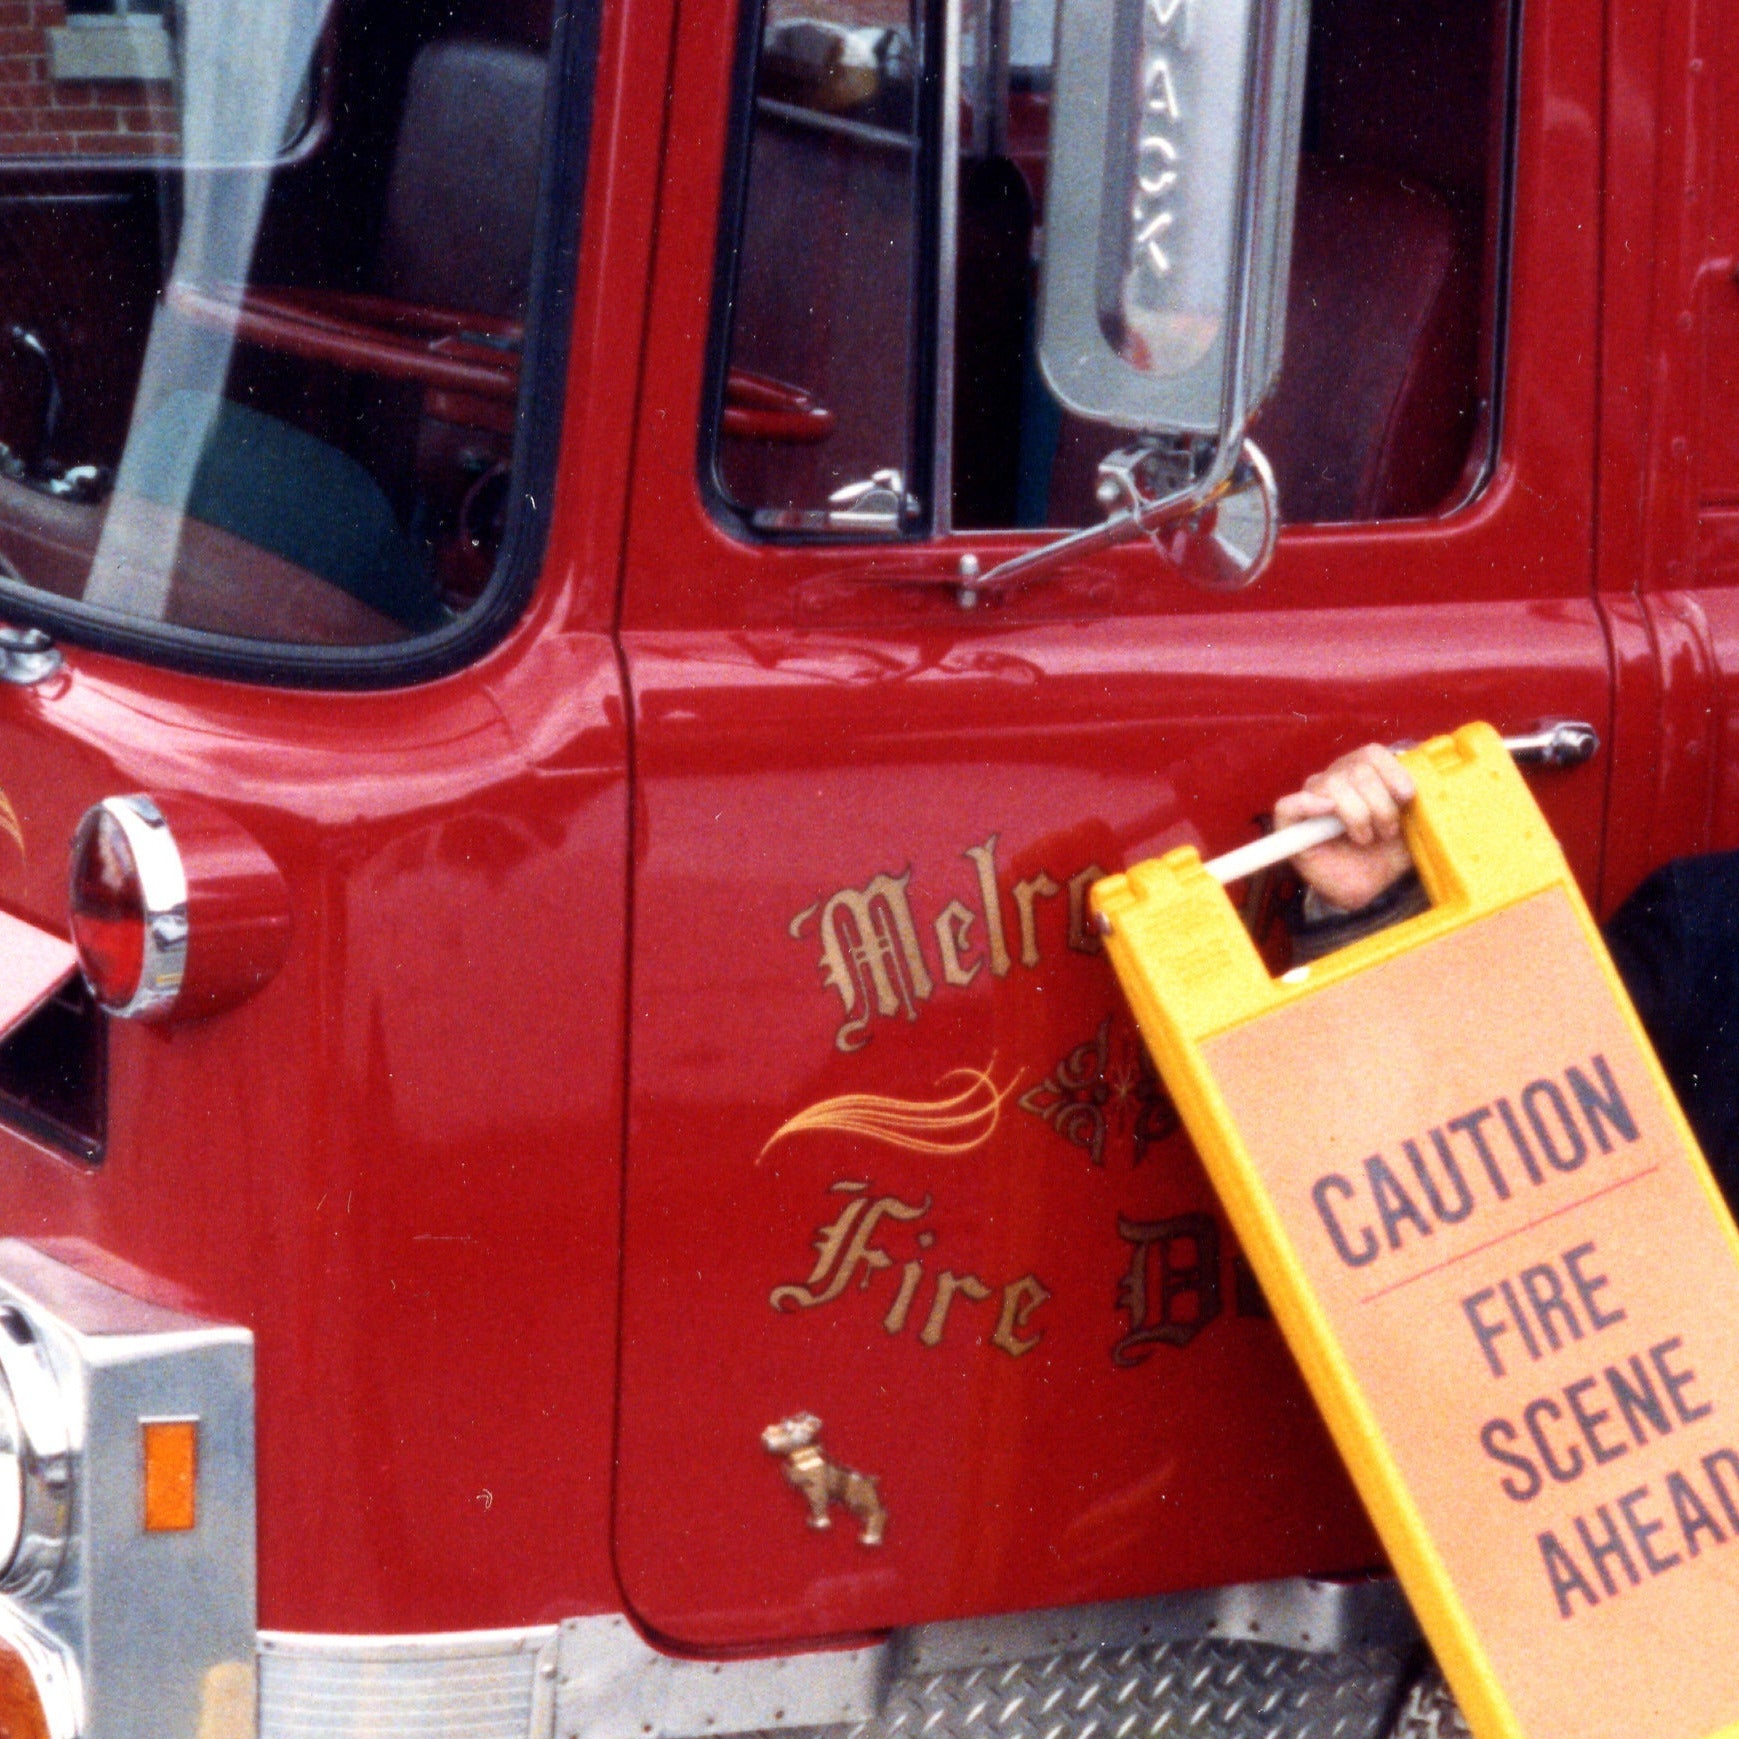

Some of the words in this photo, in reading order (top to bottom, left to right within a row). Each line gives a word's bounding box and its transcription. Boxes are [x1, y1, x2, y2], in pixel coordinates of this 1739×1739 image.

[790, 832, 1108, 1054] Melro
[1310, 1054, 1642, 1268] CAUTION
[768, 1180, 1050, 1358] Fire
[1461, 1241, 1627, 1379] FIRE
[1480, 1336, 1714, 1503] SCENE
